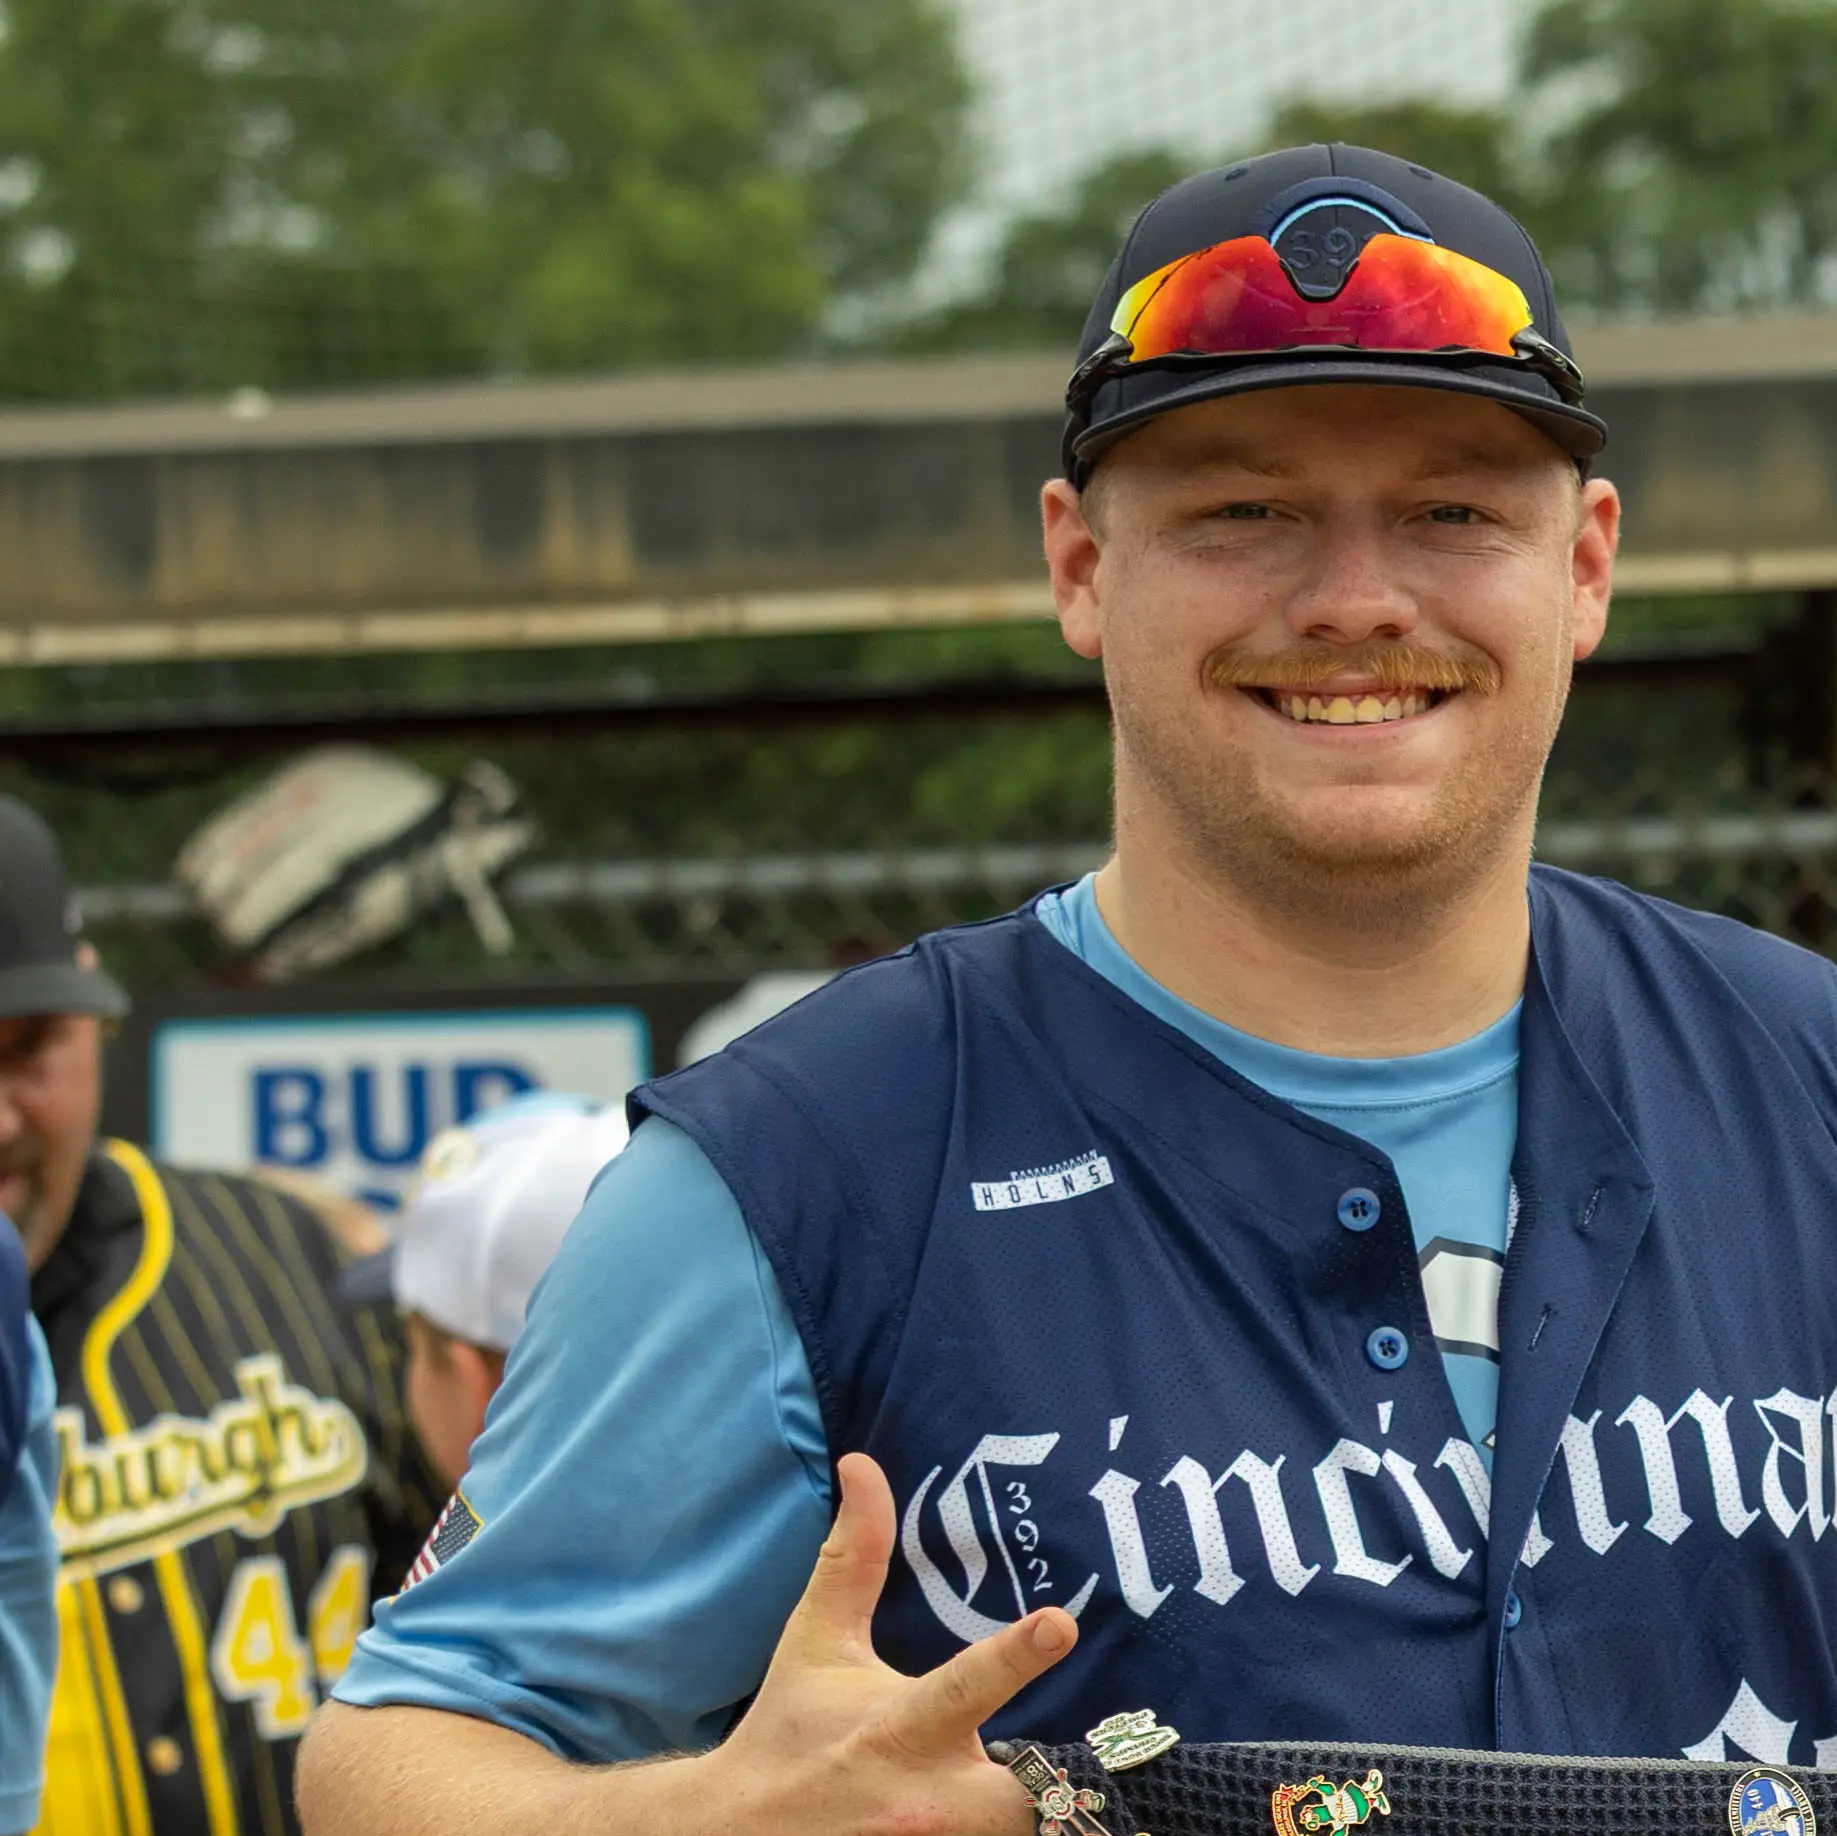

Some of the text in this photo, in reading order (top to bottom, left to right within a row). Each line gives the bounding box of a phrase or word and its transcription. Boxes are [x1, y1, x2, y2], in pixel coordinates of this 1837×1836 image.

[1007, 1480, 1052, 1591] 392
[212, 1548, 372, 1738] 44
[1748, 1789, 1764, 1811] 440
